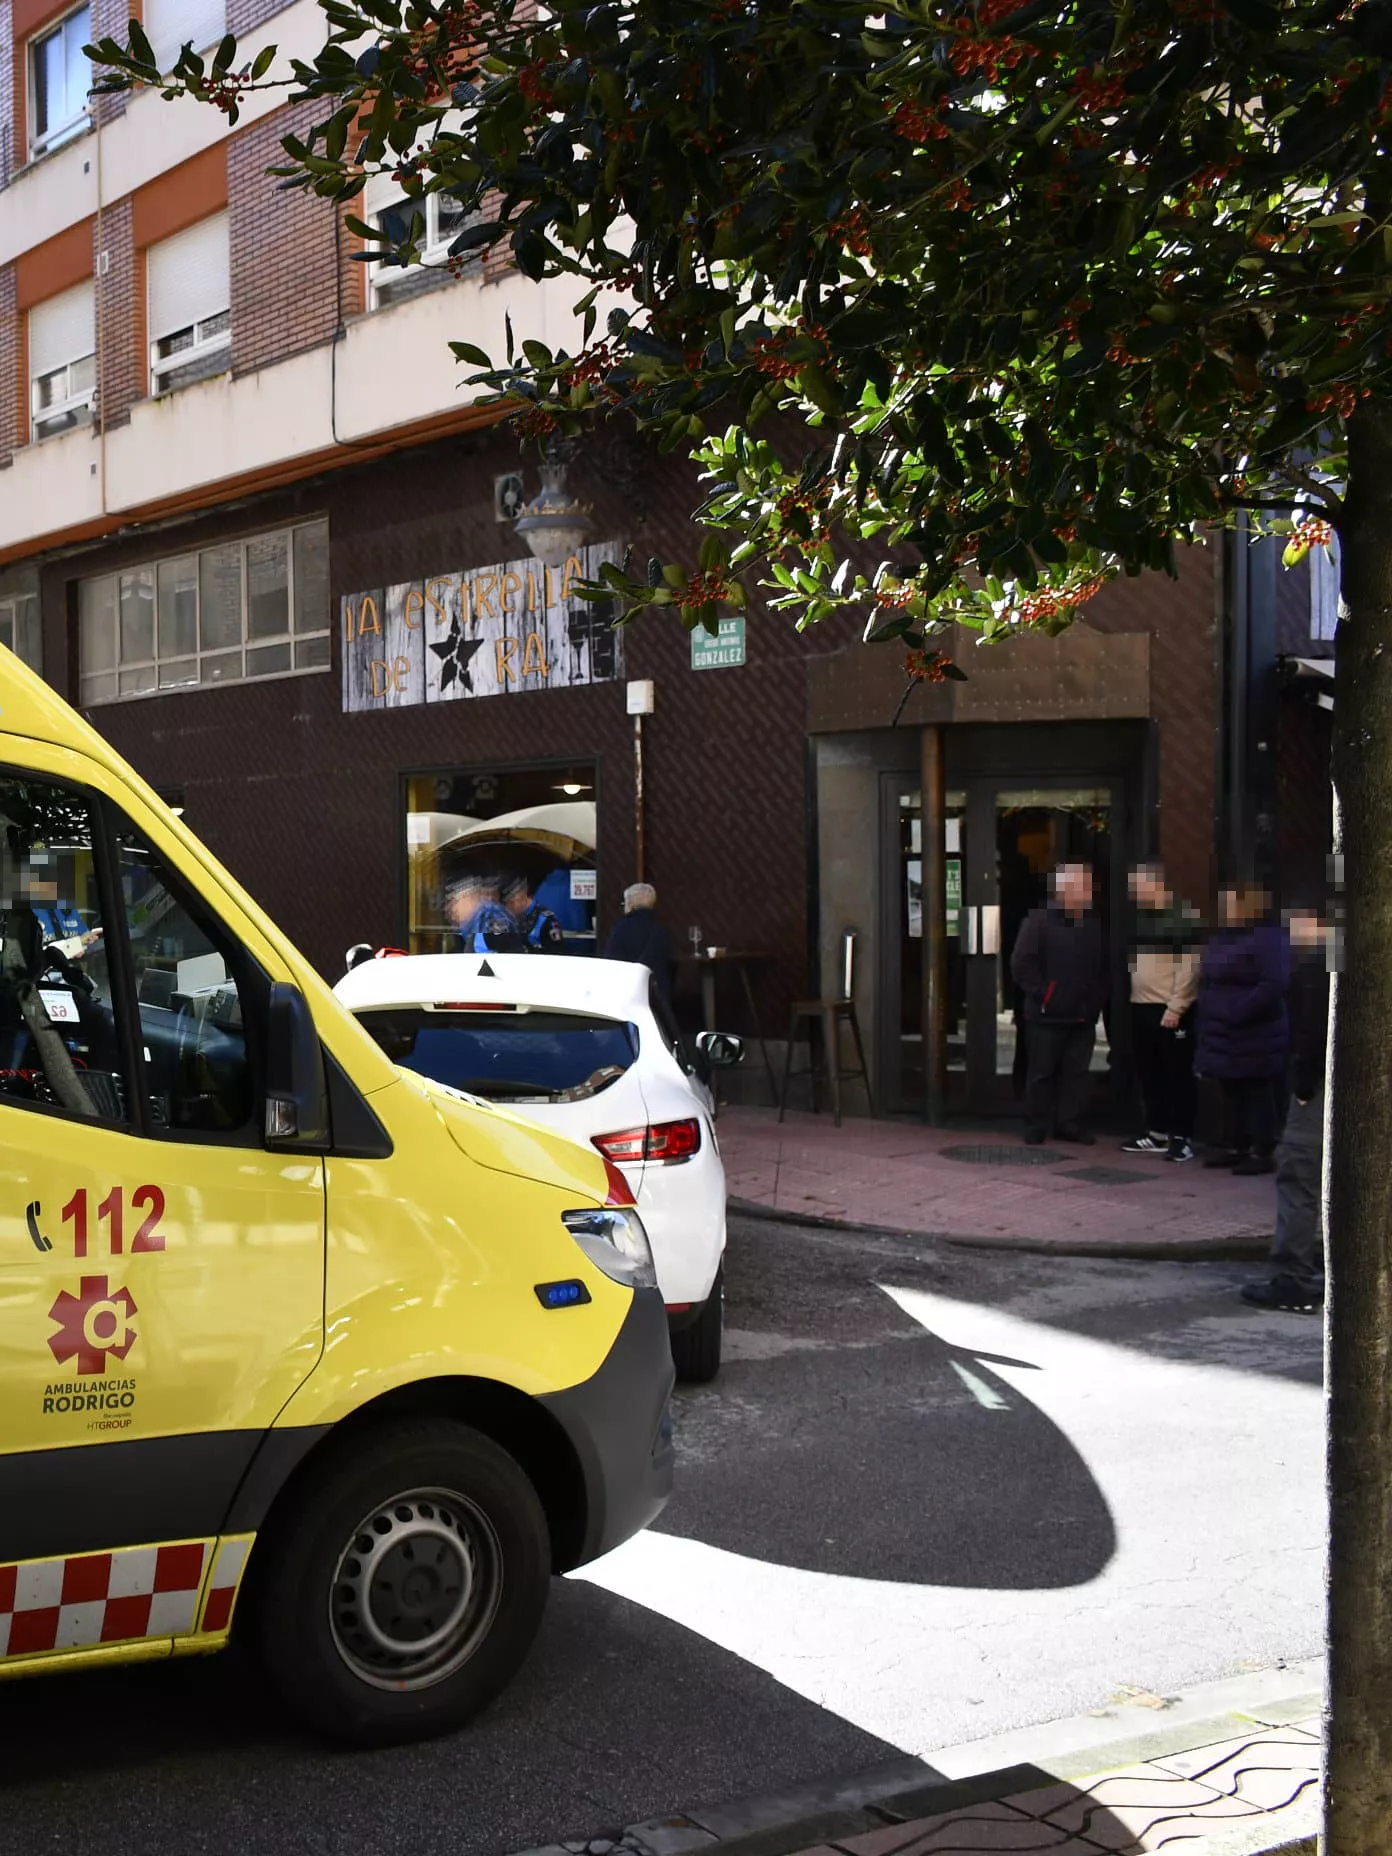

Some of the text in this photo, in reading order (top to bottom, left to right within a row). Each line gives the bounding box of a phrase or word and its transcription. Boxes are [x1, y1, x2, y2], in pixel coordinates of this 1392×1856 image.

[719, 622, 737, 635] LLE
[496, 632, 549, 683] RA
[62, 1184, 166, 1258] 112
[44, 1379, 136, 1395] AMBULANCIAS
[42, 1392, 135, 1414] RODRIGO
